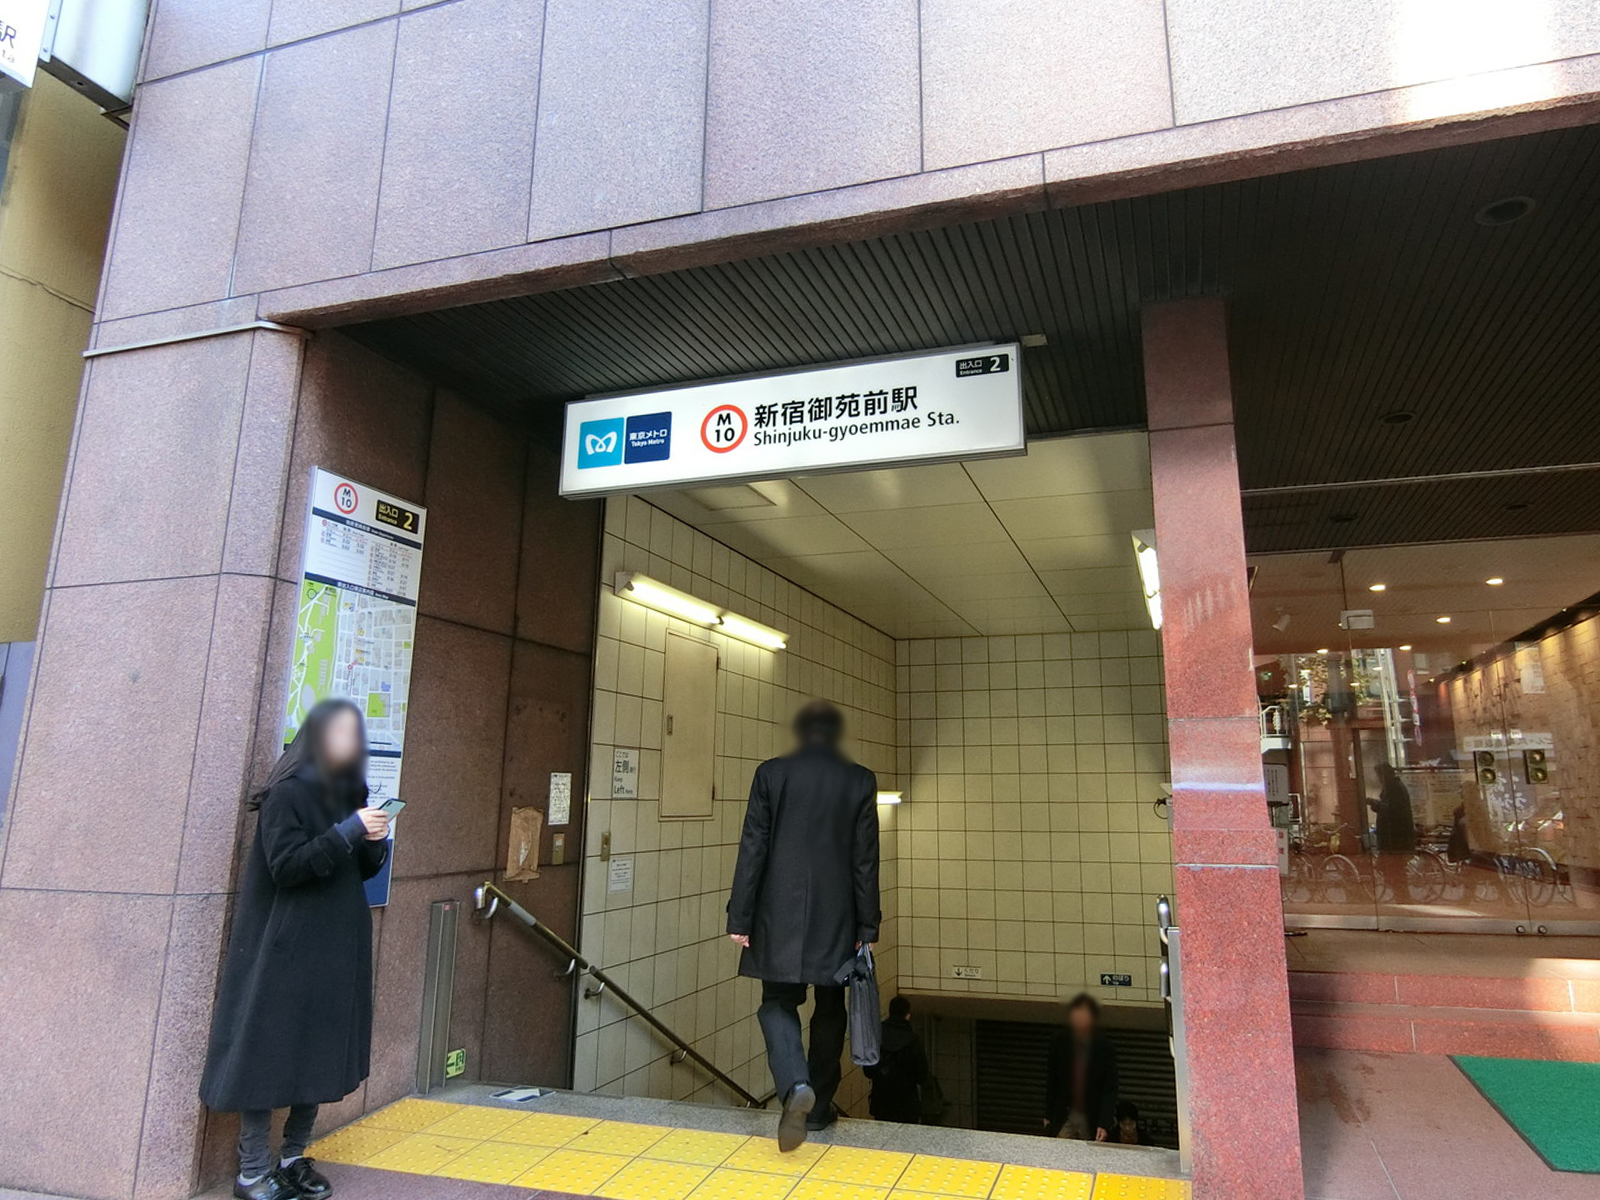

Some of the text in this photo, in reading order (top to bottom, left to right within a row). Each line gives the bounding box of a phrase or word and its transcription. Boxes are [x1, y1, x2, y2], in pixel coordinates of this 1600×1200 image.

[960, 356, 1001, 372] 出入口 2
[754, 386, 918, 429] 新宿御苑前駅
[716, 412, 732, 426] M
[629, 428, 668, 441] 東京メトロ
[715, 427, 735, 443] 10
[753, 411, 960, 447] Shinjuku-gyoemmae Sta.
[631, 438, 665, 448] Tokyo Metro
[342, 488, 351, 497] M
[341, 497, 352, 509] 10
[378, 503, 399, 518] 出入口
[403, 511, 413, 530] 2
[614, 785, 625, 794] Left
